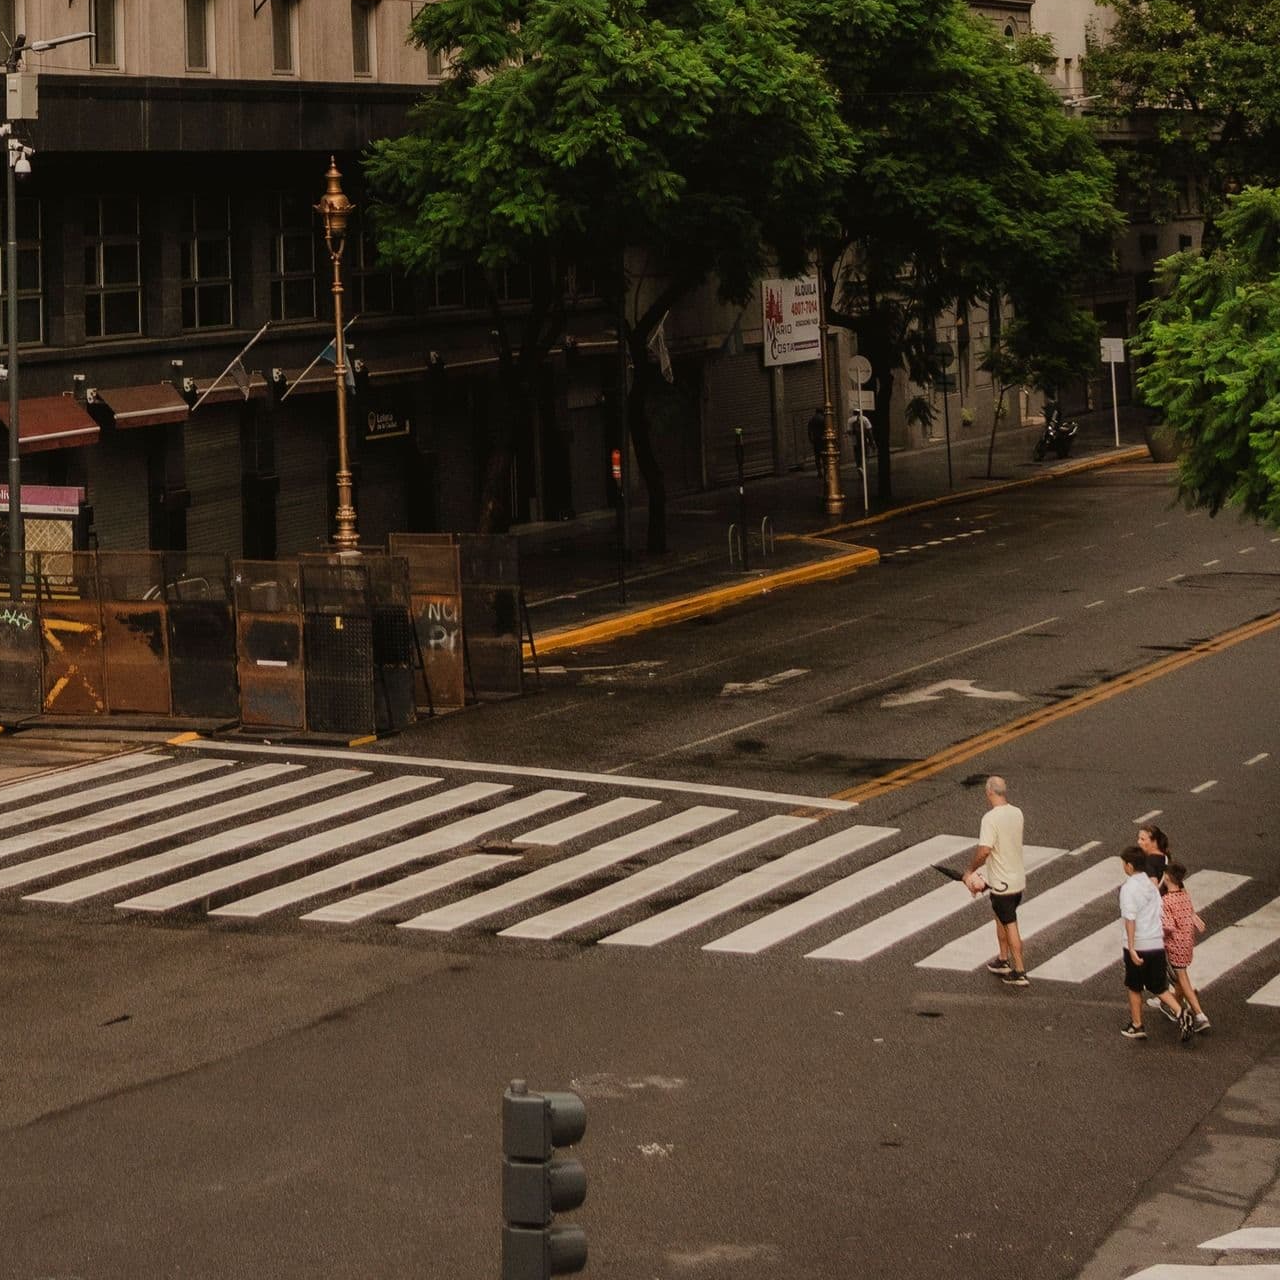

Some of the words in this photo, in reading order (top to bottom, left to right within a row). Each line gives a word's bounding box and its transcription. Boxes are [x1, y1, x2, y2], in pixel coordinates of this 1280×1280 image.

[794, 283, 817, 297] ALQUILA
[766, 318, 792, 341] MARIO
[770, 338, 795, 360] COSTA
